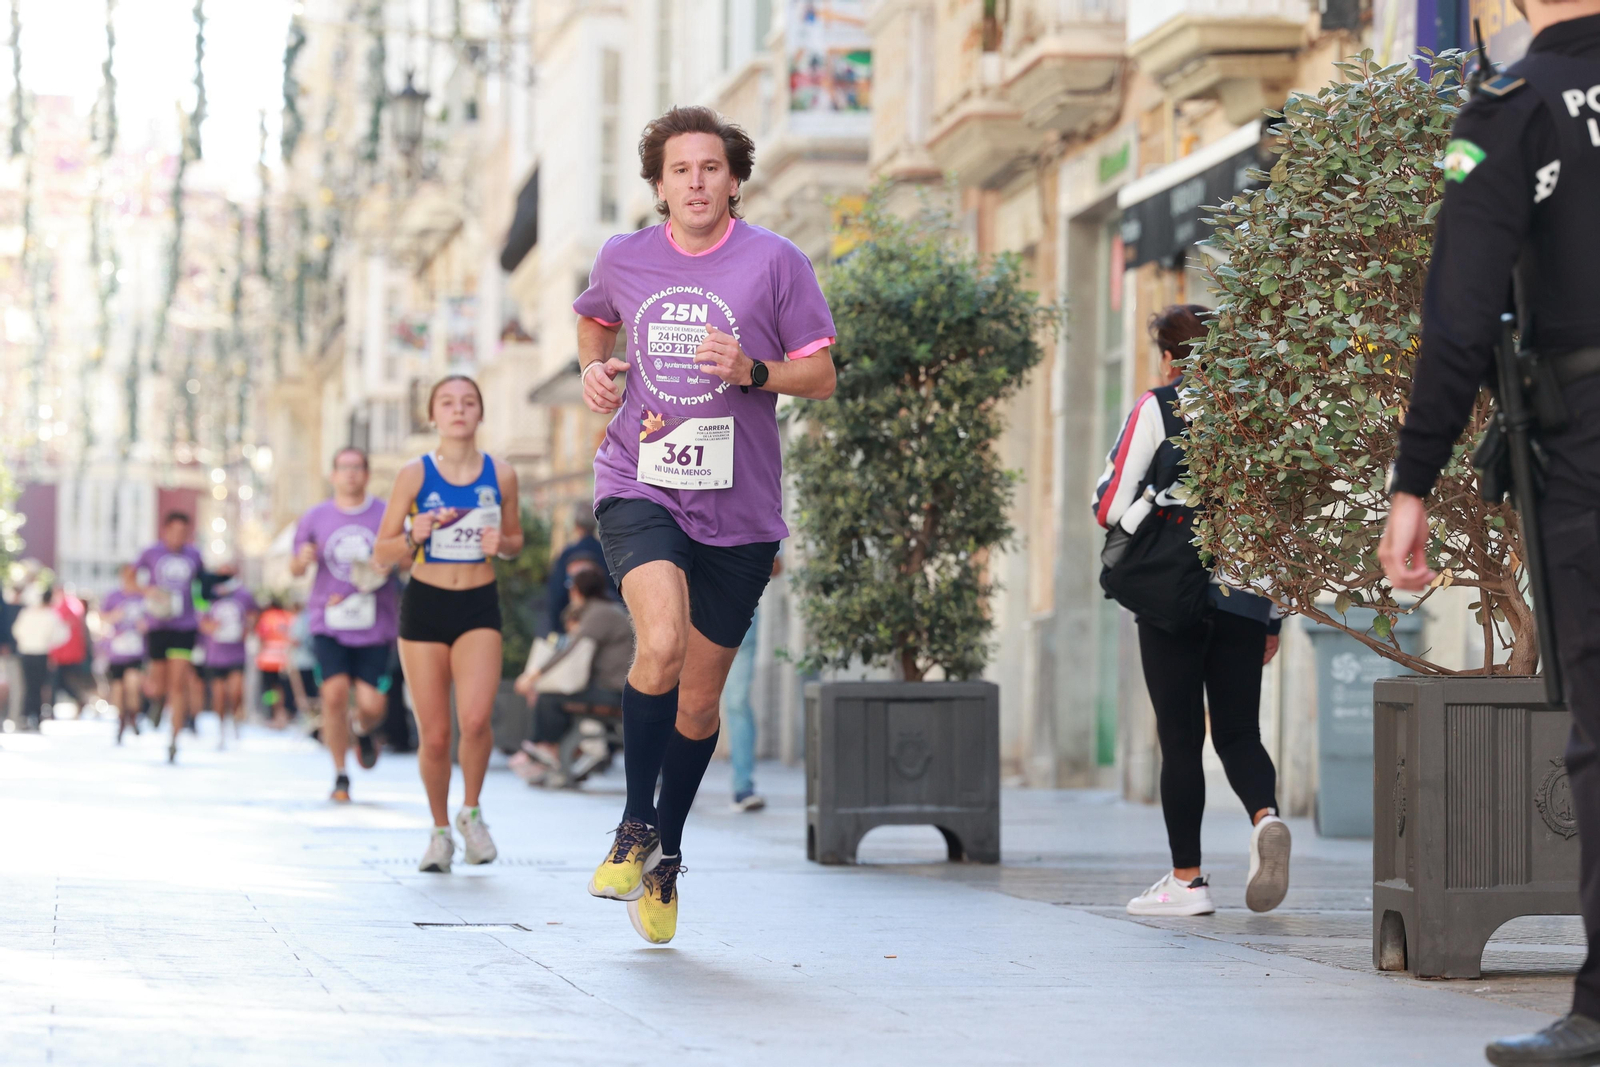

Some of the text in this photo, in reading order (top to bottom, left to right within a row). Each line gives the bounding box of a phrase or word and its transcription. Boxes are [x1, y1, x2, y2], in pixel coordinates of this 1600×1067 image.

[634, 286, 704, 324] INTERNACIONAL
[705, 291, 736, 326] CONTRA
[661, 302, 708, 323] 25N
[658, 331, 670, 341] 24
[651, 342, 672, 352] 900
[674, 344, 685, 353] 21
[664, 361, 692, 369] Ayuntamiento
[658, 391, 677, 404] LAS
[680, 392, 713, 405] HACIA
[662, 442, 704, 466] 361
[654, 464, 712, 476] NI UNA MENOS
